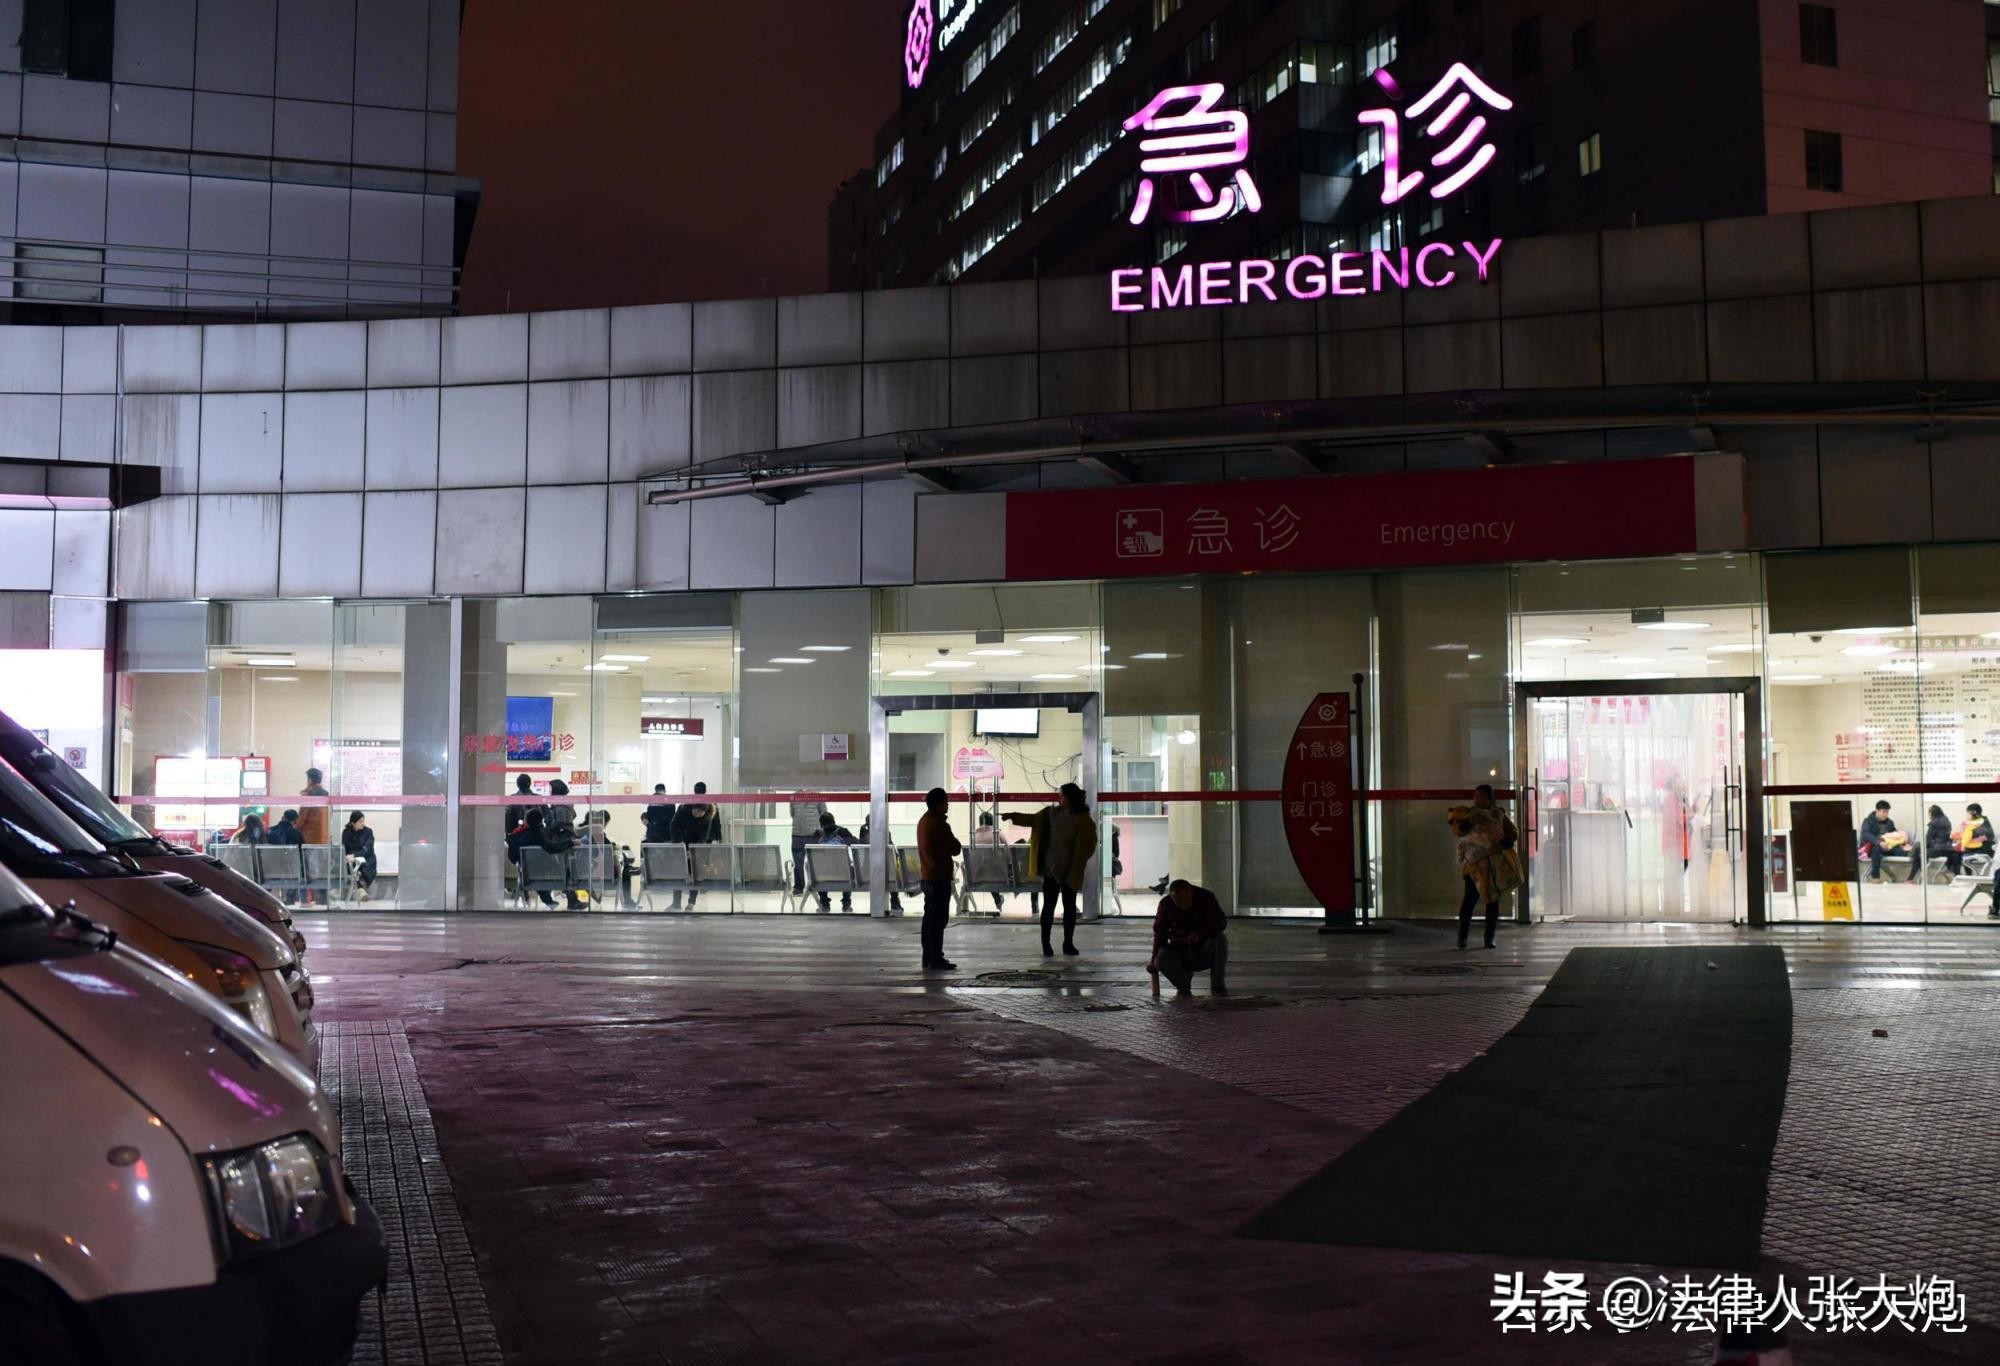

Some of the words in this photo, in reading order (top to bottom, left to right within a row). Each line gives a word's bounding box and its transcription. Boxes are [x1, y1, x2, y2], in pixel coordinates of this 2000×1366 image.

[1123, 61, 1513, 225] 急诊
[1111, 238, 1502, 312] EMERGENCY
[1186, 503, 1301, 555] 急诊
[1380, 520, 1515, 547] Emergency
[1309, 741, 1345, 758] 急诊
[1302, 781, 1337, 798] 门诊
[1289, 800, 1345, 818] 夜门诊
